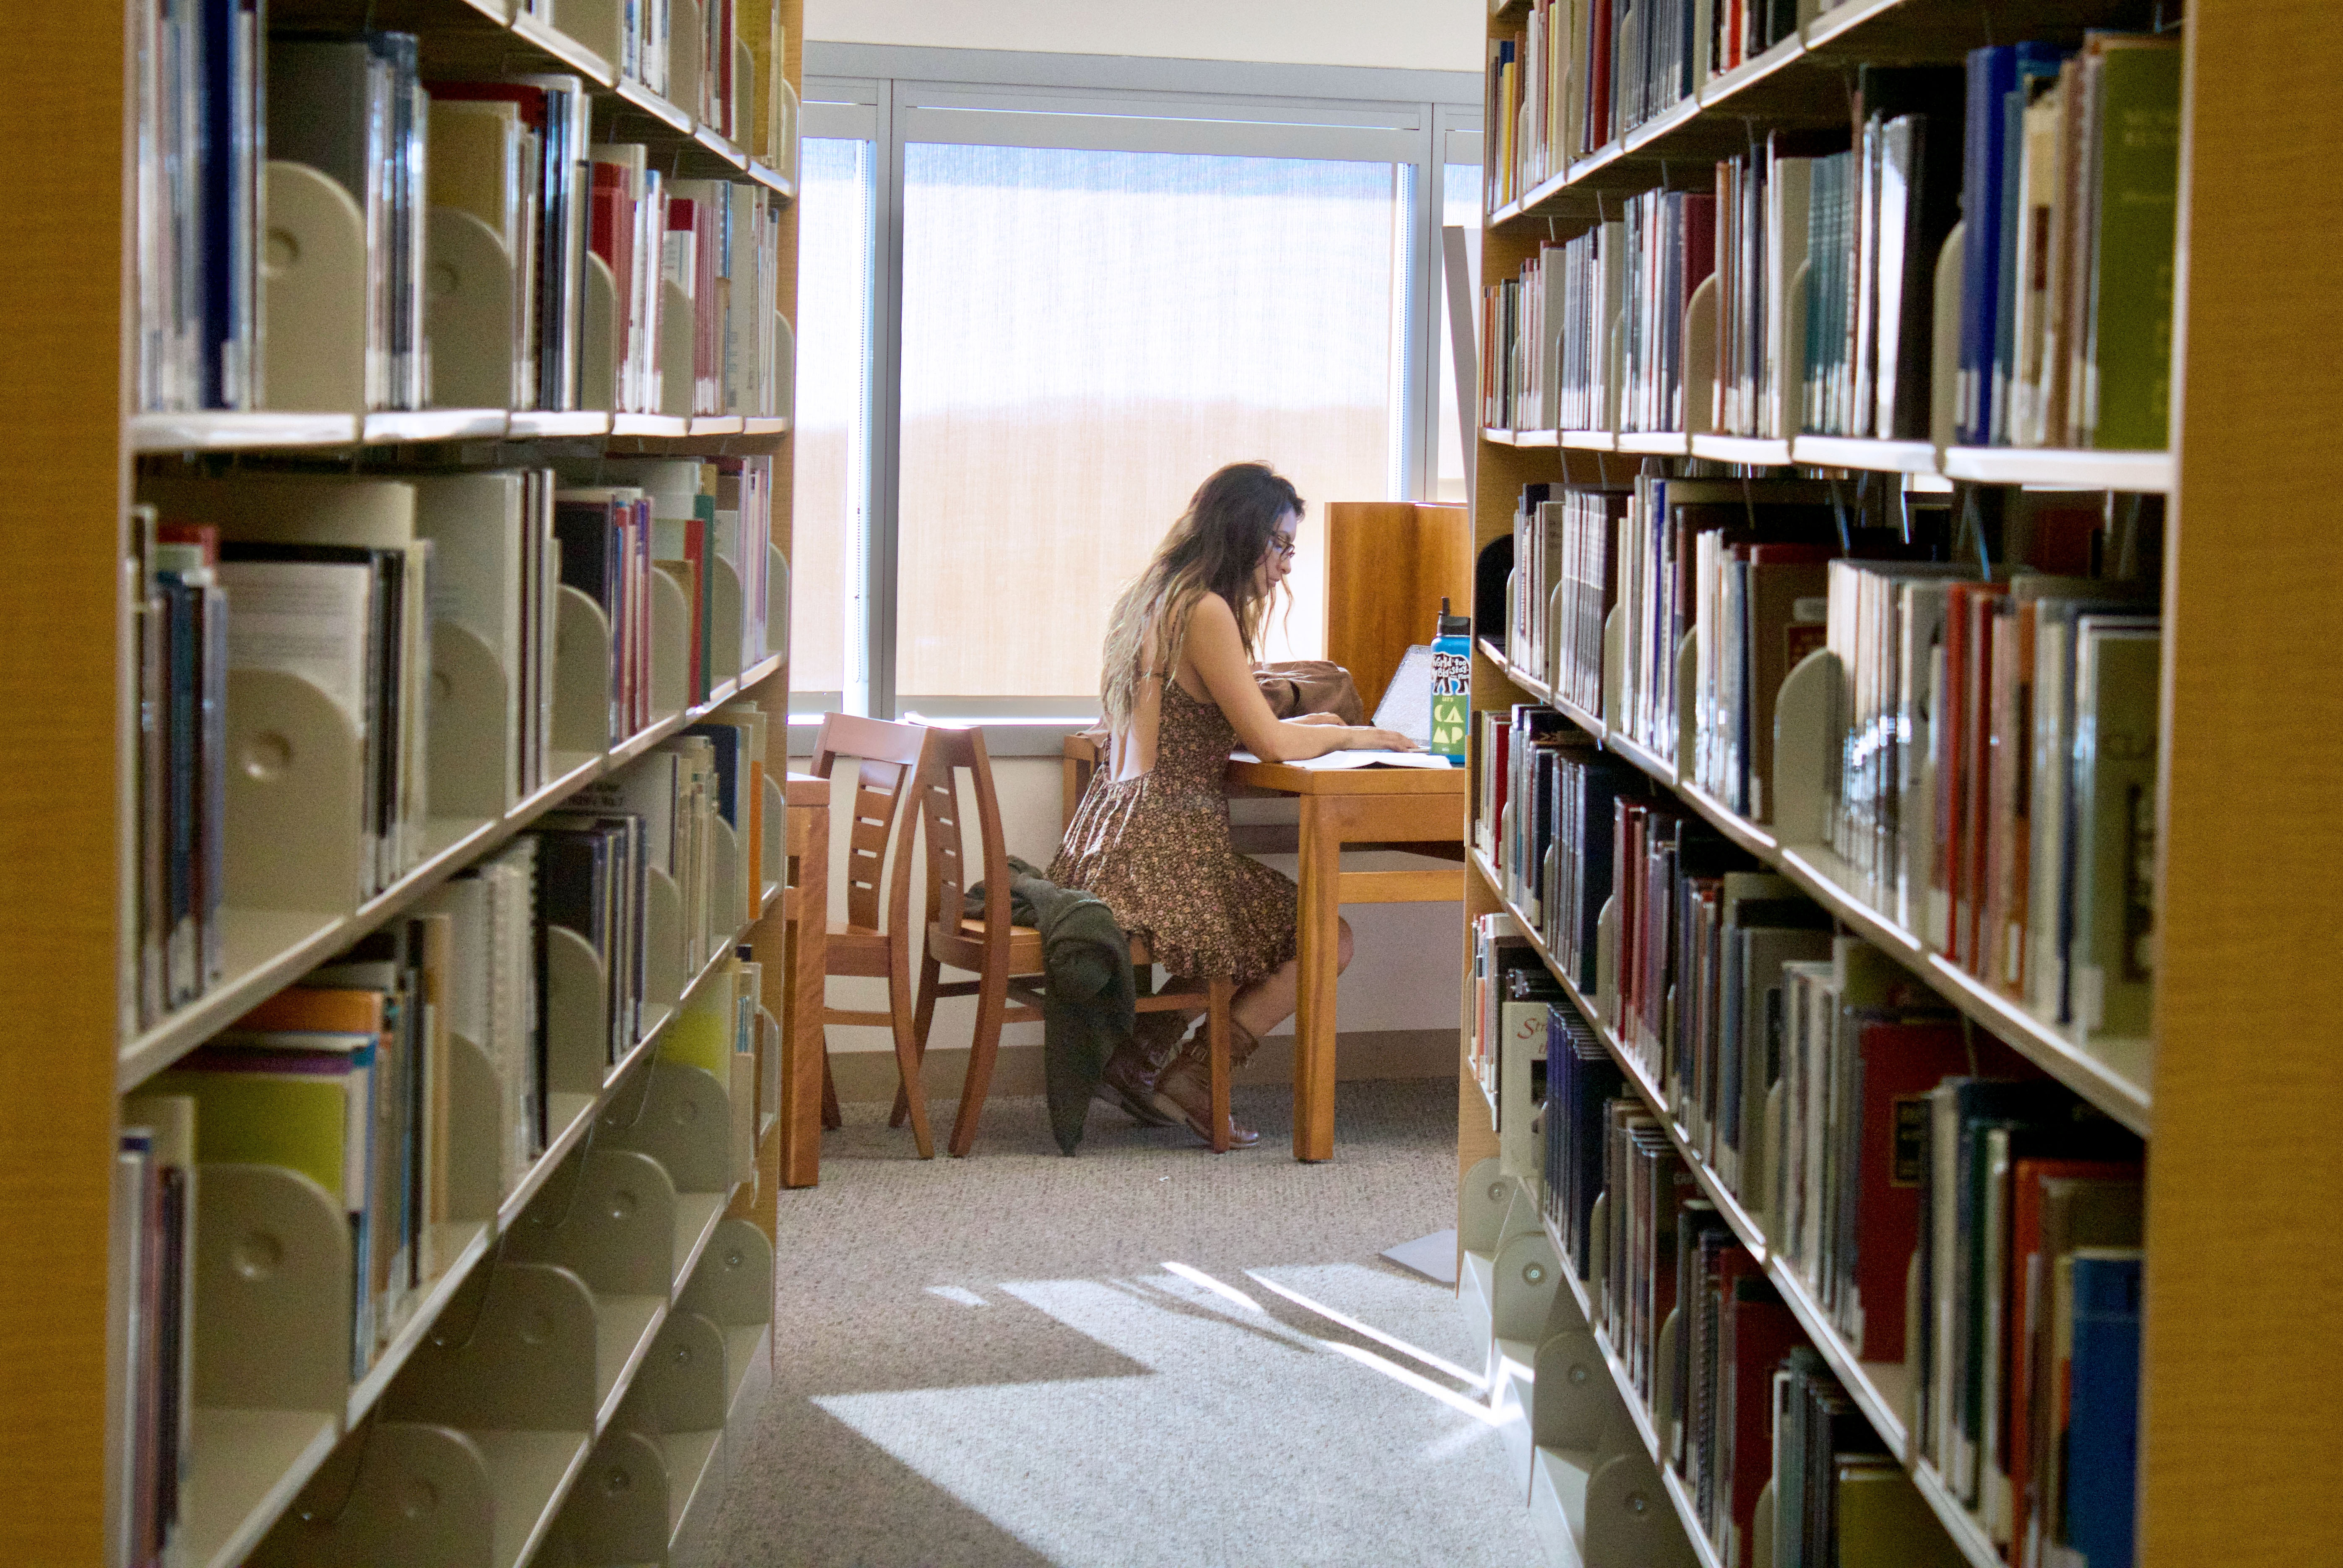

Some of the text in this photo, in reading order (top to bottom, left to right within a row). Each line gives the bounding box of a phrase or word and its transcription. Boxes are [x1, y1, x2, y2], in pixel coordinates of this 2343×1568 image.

[1454, 658, 1467, 666] too
[1438, 666, 1467, 678] Big Stay
